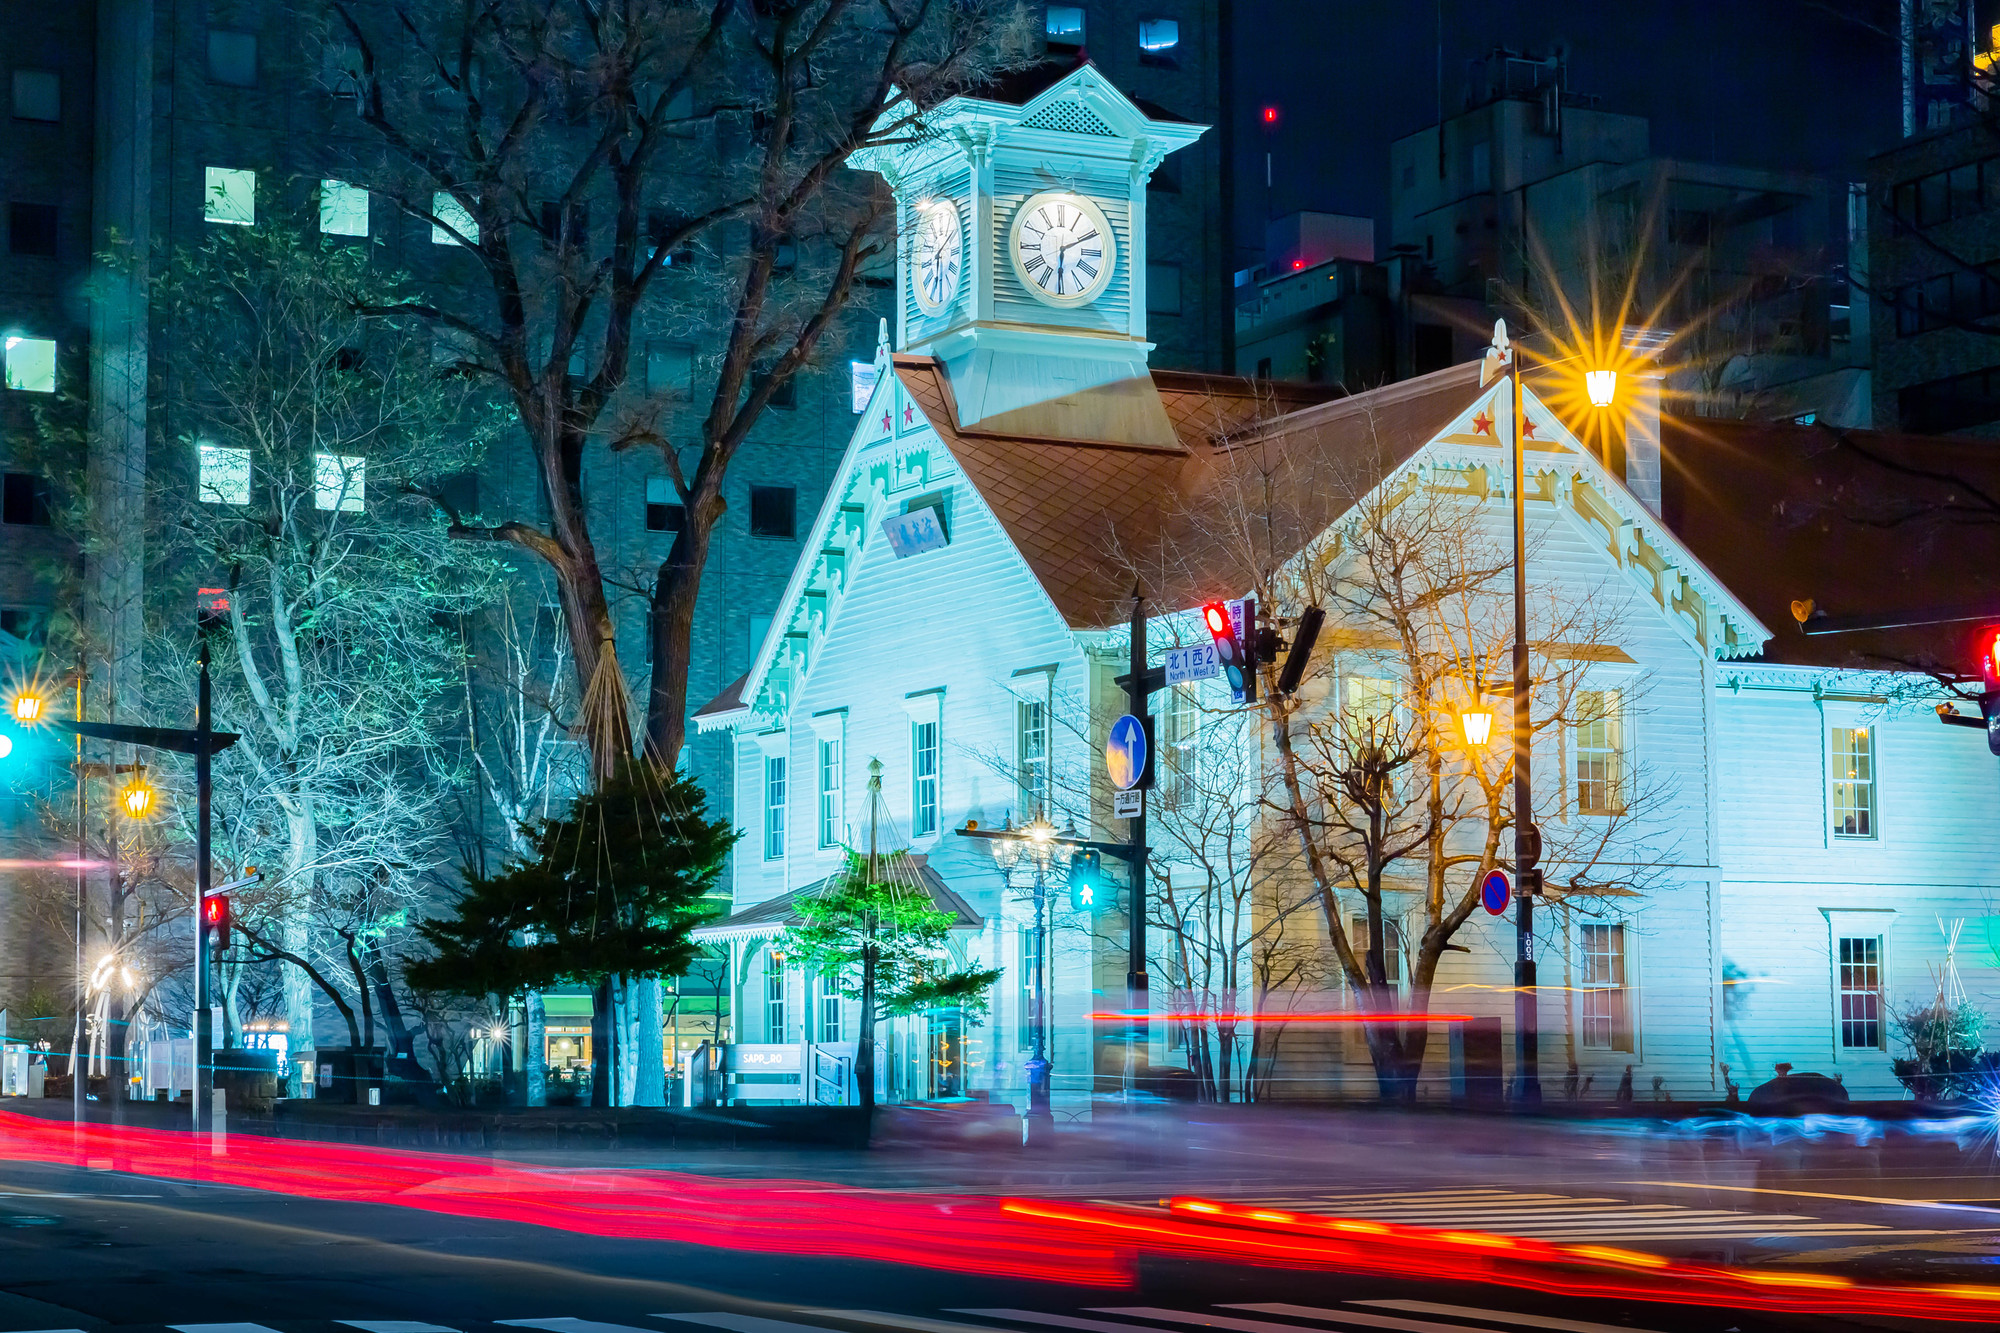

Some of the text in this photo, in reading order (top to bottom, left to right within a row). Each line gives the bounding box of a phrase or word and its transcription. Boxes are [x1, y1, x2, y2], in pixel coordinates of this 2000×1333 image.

[1169, 646, 1214, 670] 北1西2
[1169, 671, 1186, 681] North
[1193, 667, 1209, 677] West
[1211, 665, 1216, 674] 2
